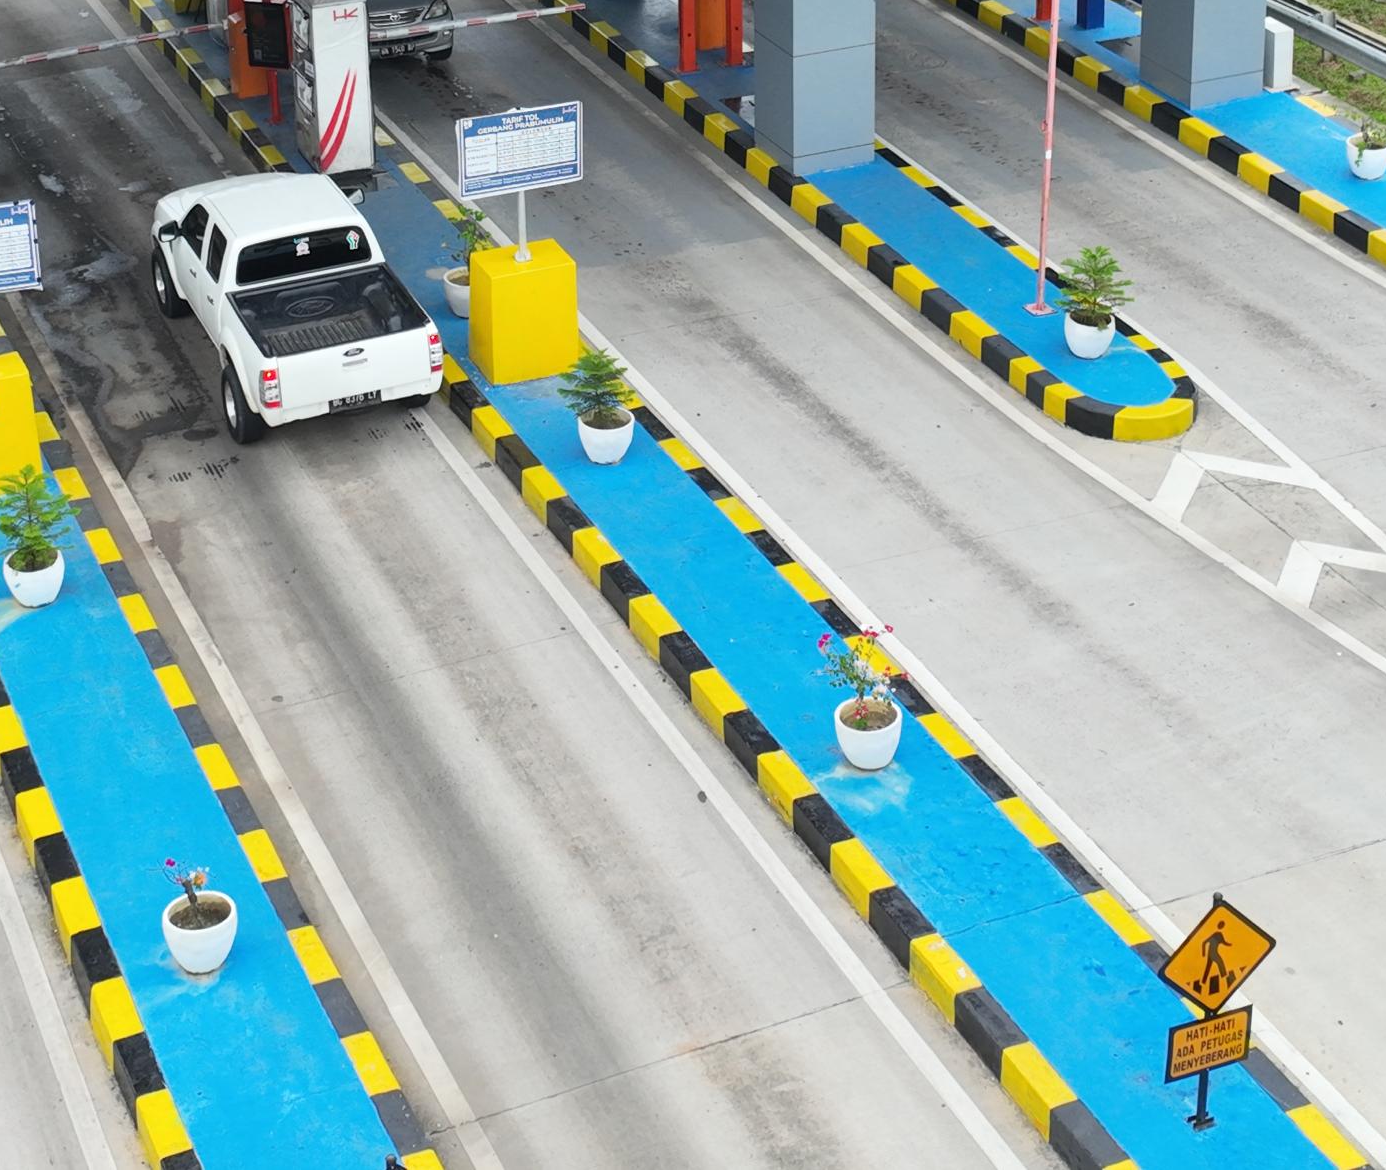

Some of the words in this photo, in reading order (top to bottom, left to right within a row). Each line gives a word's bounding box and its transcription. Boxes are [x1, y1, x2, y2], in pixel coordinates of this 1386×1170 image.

[333, 7, 359, 22] HK
[1176, 1044, 1195, 1058] ADA
[1200, 1029, 1244, 1052] PETUGAS
[1173, 1044, 1243, 1073] MENYEBERANG
